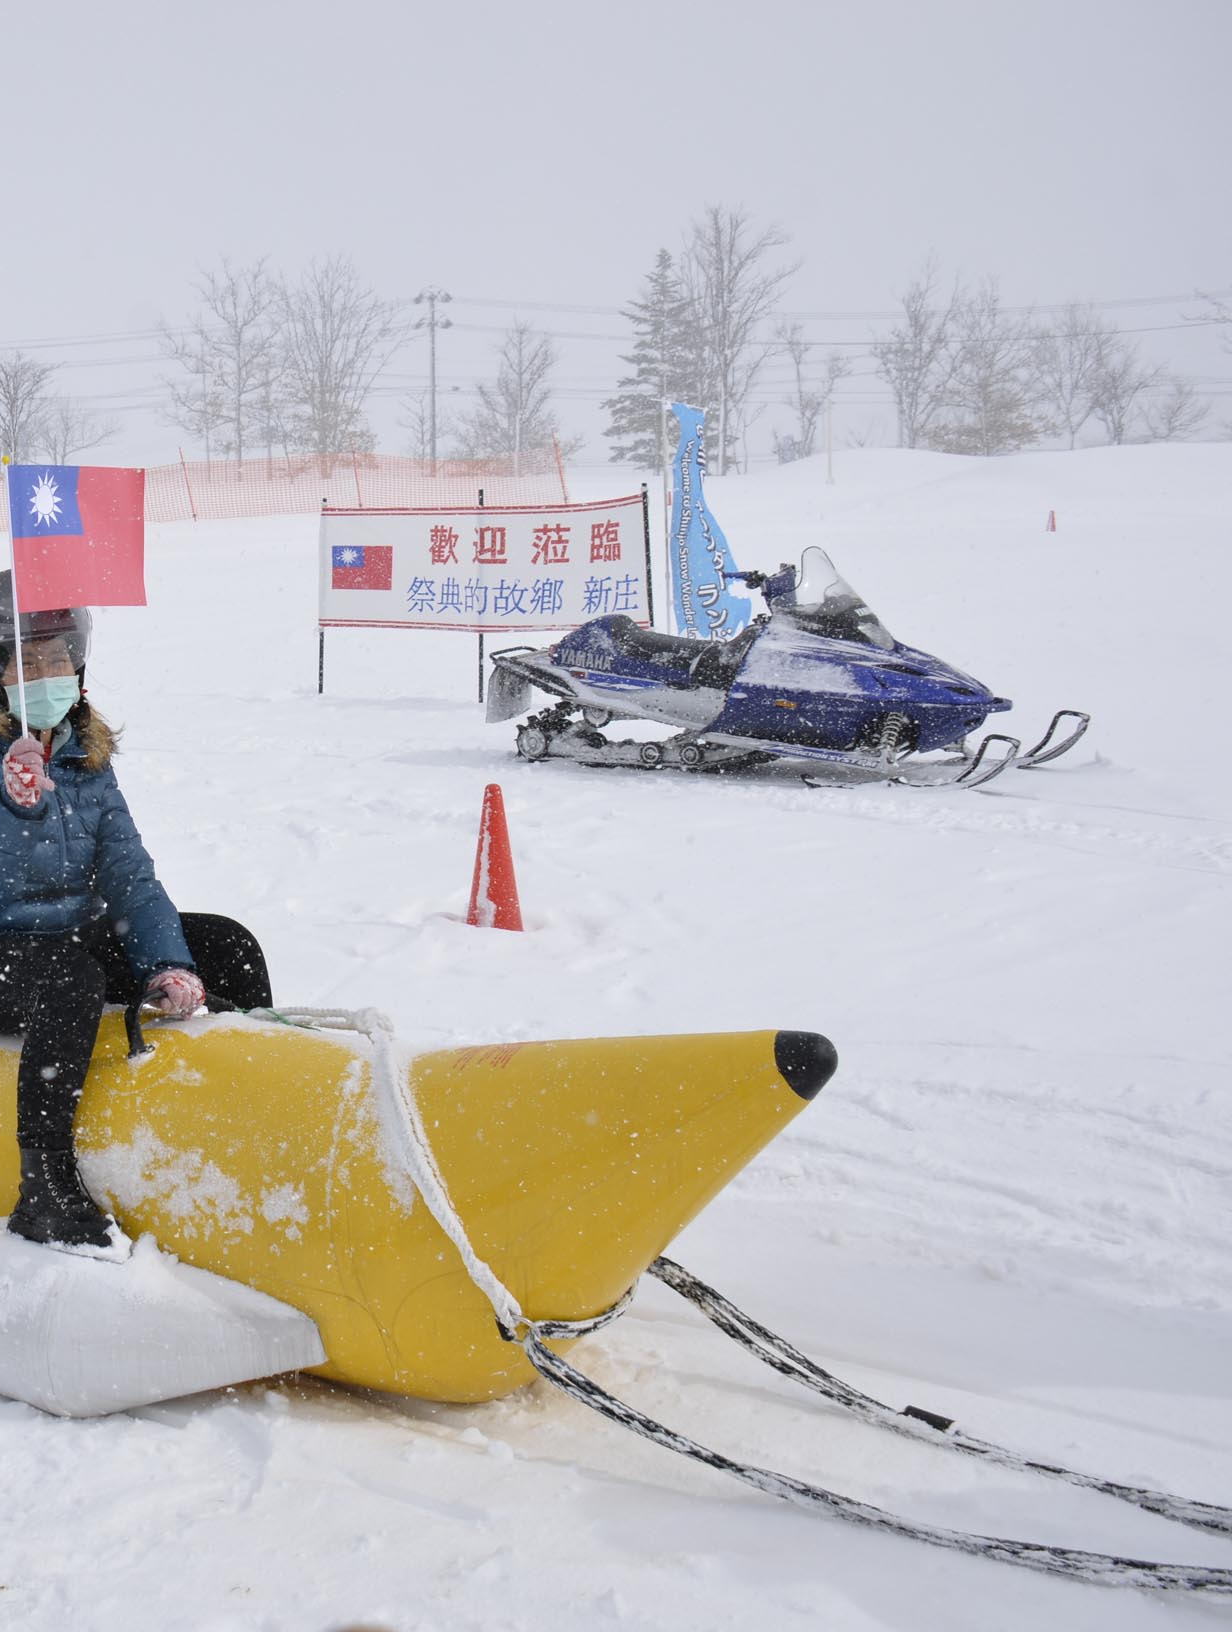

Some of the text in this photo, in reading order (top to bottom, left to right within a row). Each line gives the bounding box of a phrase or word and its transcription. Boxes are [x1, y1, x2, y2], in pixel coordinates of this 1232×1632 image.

[429, 519, 622, 566] 歡迎蒞臨
[676, 440, 698, 640] Welcome to Shinjo Snow Wonder La
[581, 574, 640, 614] 新庄
[561, 648, 613, 671] YAMAHA
